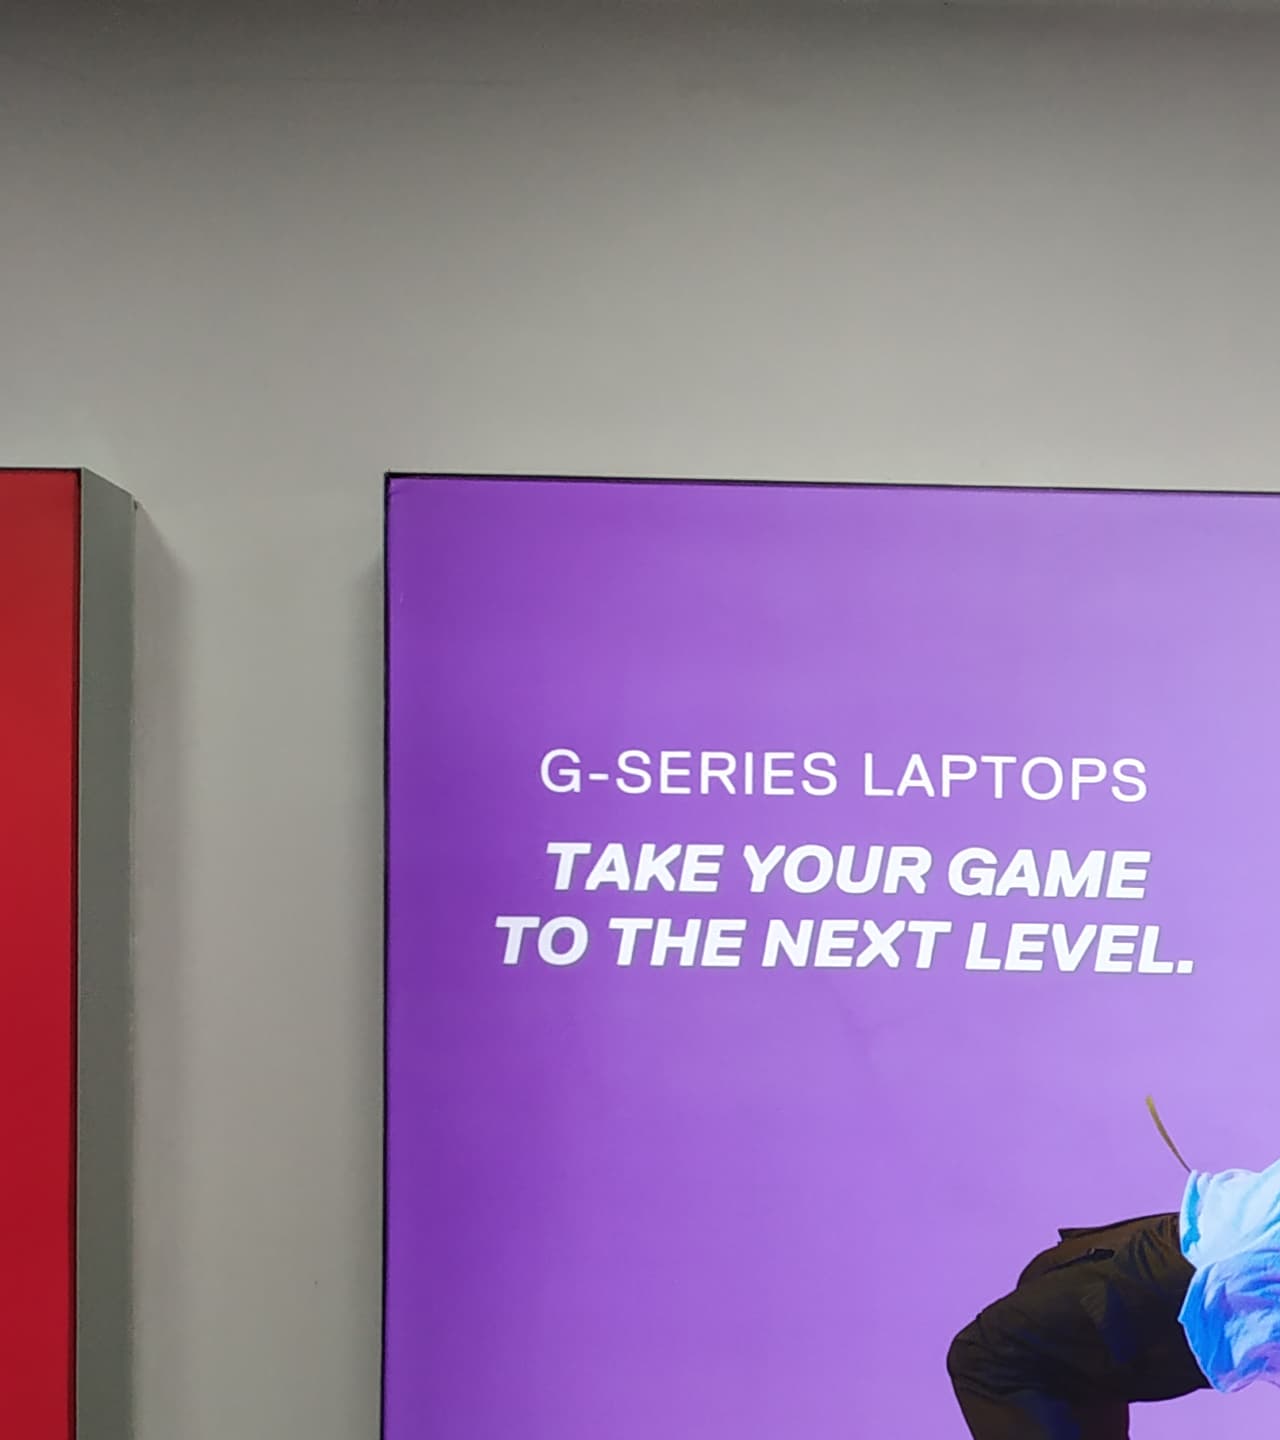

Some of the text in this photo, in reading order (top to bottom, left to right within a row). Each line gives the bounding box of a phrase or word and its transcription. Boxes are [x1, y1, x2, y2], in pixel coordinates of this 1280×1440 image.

[540, 749, 1147, 802] G-SERIES LAPTOPS
[546, 842, 1150, 900] TAKE YOUR GAME
[495, 916, 1195, 974] TO THE NEXT LEVEL.
